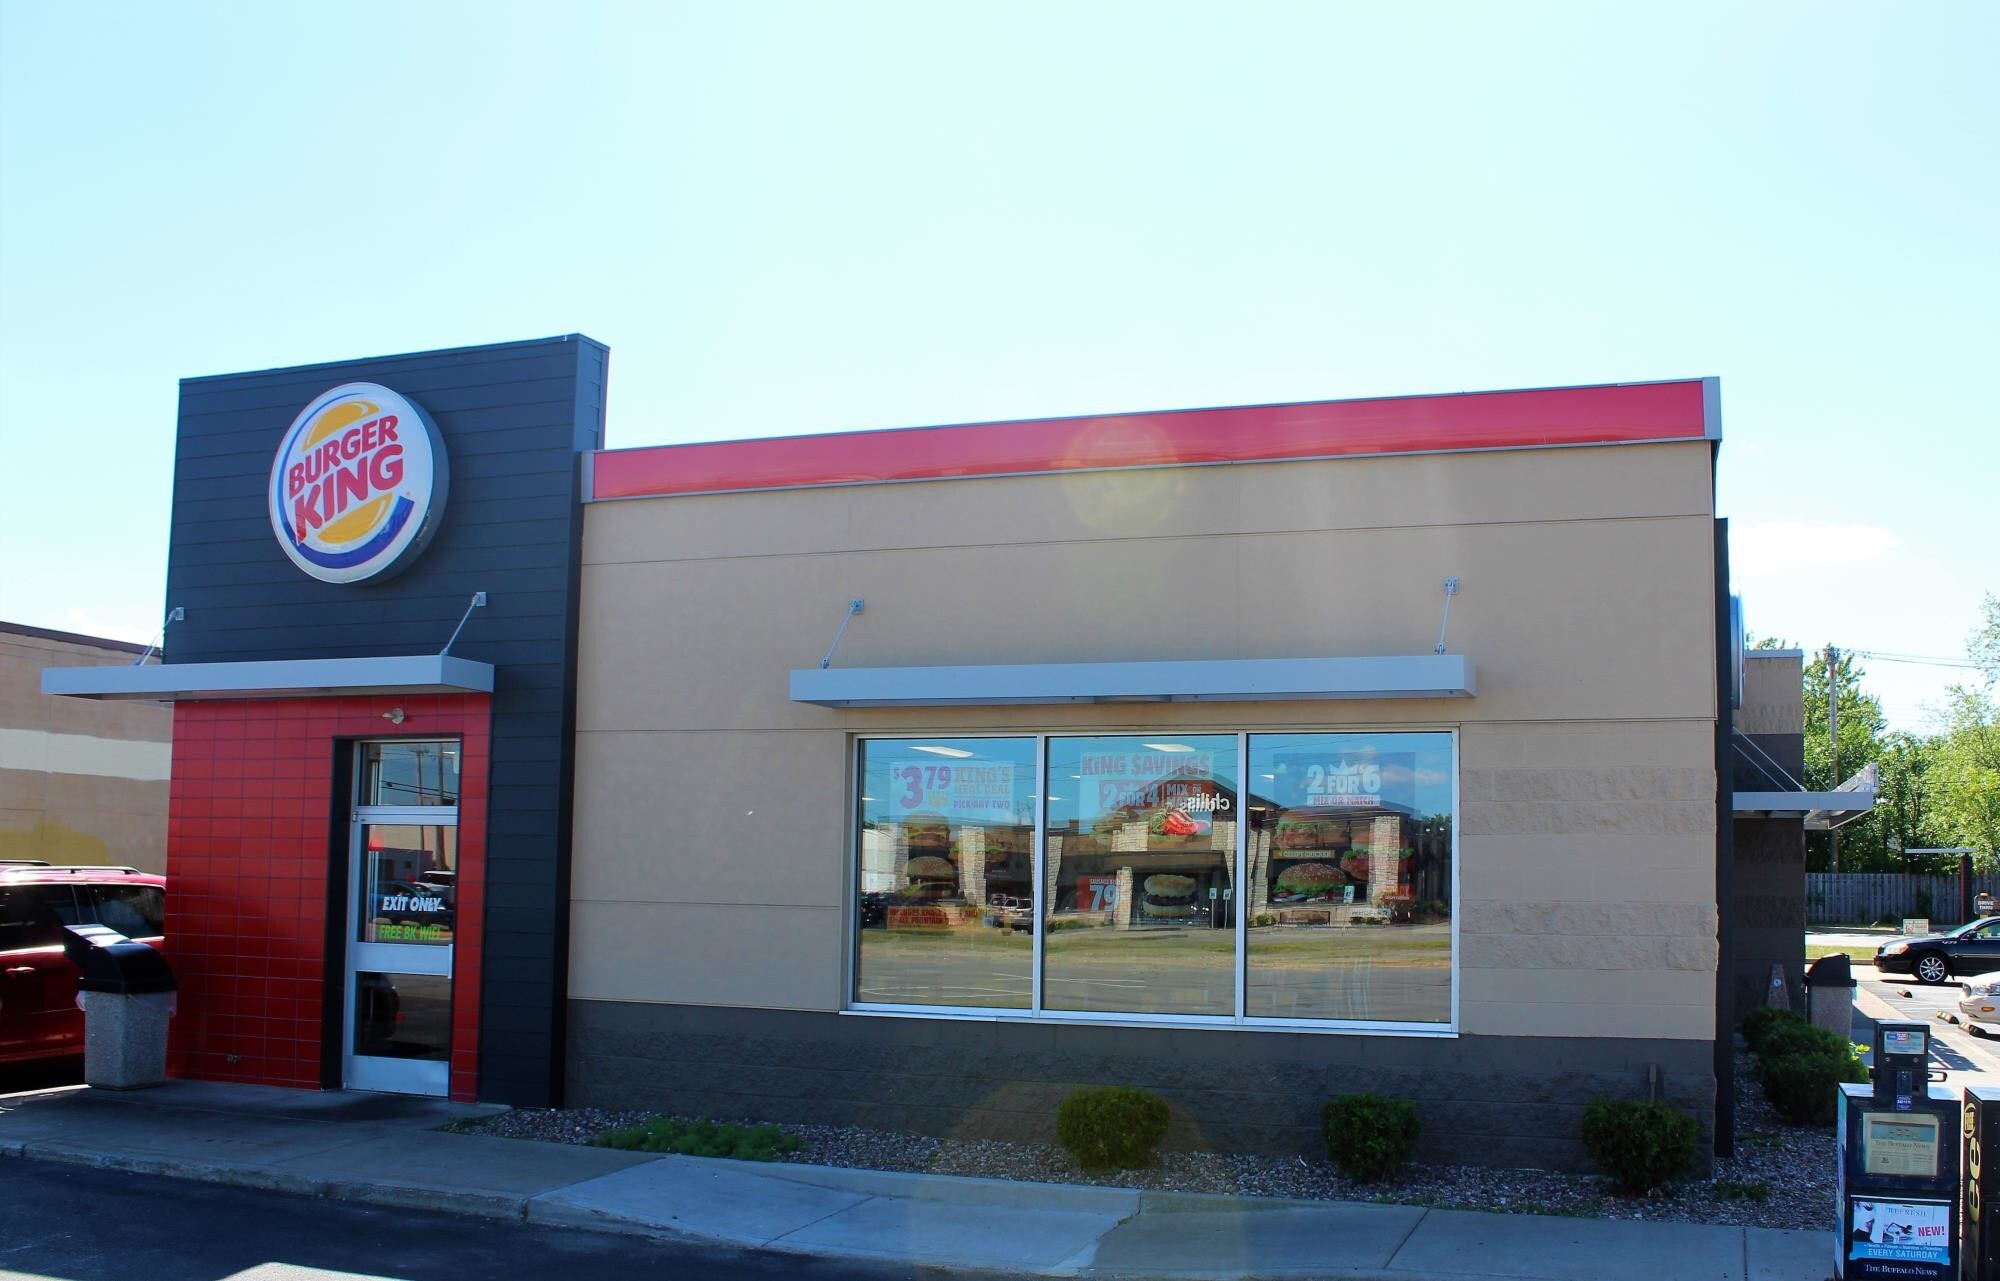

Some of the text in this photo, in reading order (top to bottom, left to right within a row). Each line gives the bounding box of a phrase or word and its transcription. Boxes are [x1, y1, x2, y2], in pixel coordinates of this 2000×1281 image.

[289, 415, 399, 500] BURGER
[294, 443, 404, 545] KING
[1081, 756, 1126, 776] KING
[1306, 764, 1325, 794] 2
[1327, 775, 1360, 794] FOR
[1103, 783, 1118, 808] 2
[1119, 791, 1145, 807] FOR
[1166, 783, 1188, 796] MIX
[992, 799, 1010, 809] TWO
[382, 896, 442, 912] EXIT ONLY
[1090, 884, 1120, 912] 79
[379, 924, 403, 940] FREE
[404, 925, 417, 940] BK
[1917, 1225, 1945, 1237] NEW!
[1868, 1248, 1938, 1259] EVERY SATURDAY
[1881, 1265, 1915, 1275] BUFFALO
[1915, 1266, 1938, 1276] NEWS
